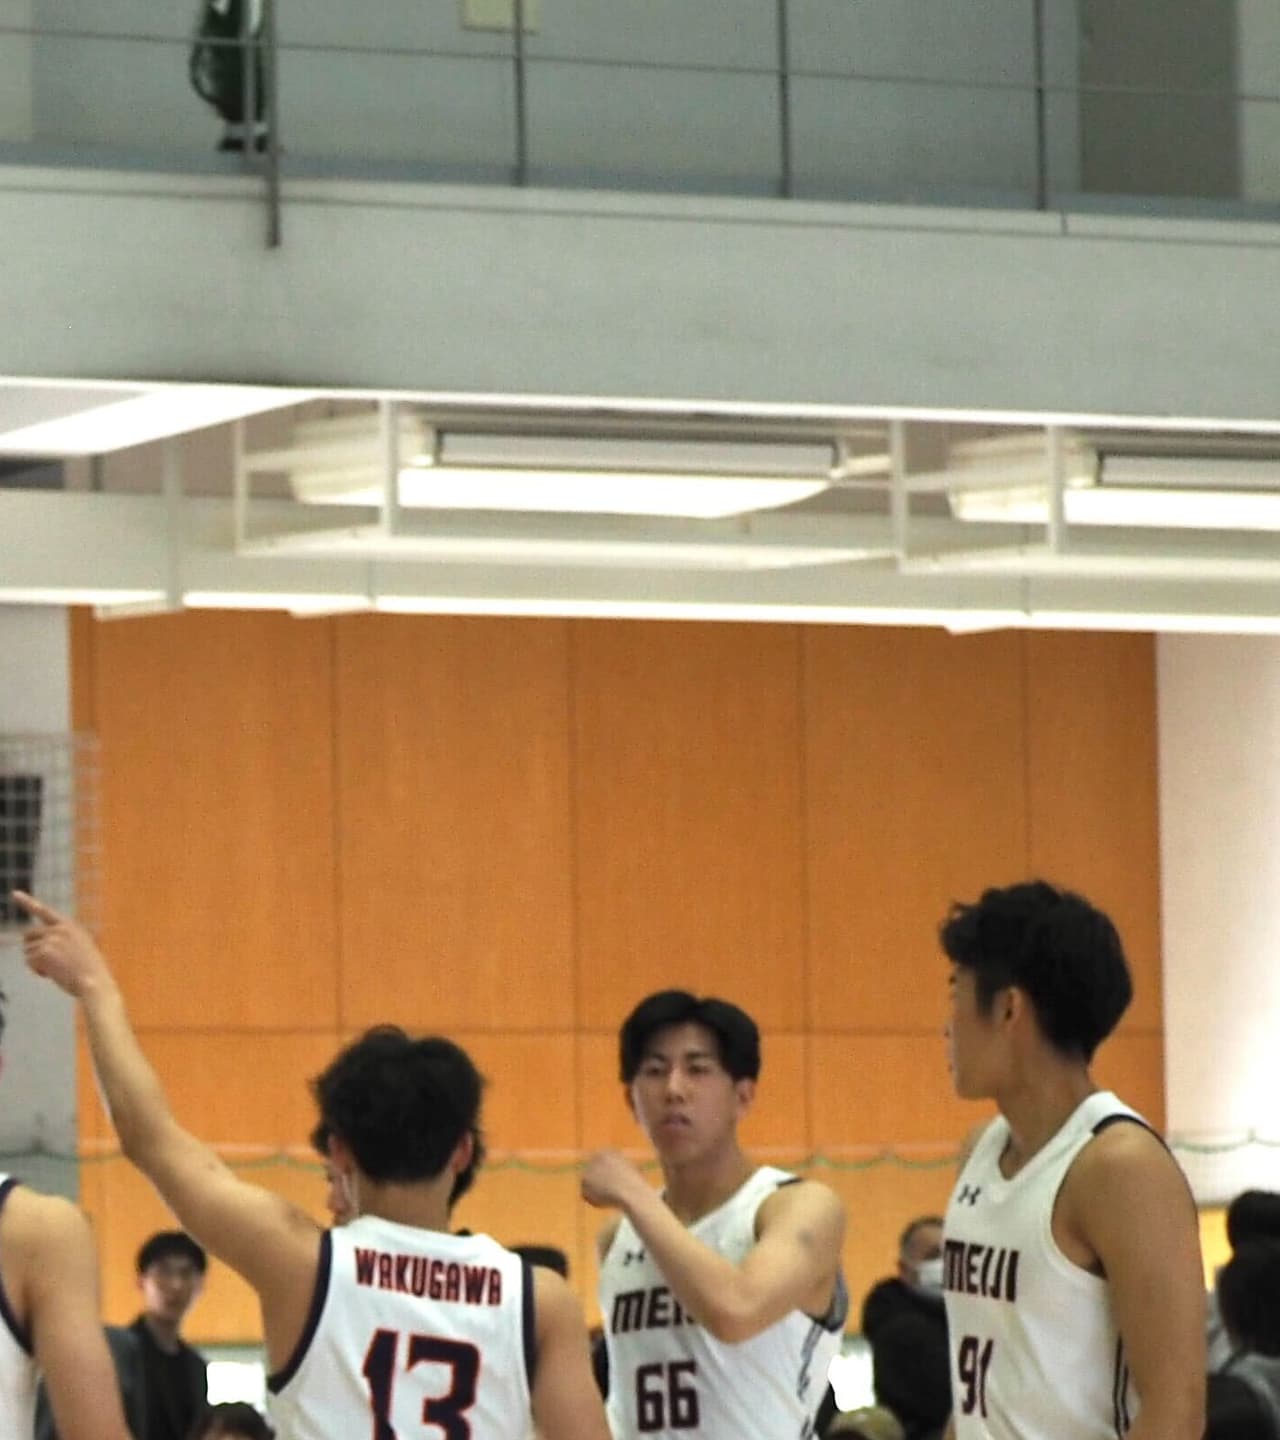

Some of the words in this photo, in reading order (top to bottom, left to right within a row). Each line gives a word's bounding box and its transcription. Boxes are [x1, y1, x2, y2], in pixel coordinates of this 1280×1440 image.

[354, 1246, 502, 1305] WAKUGAWA
[636, 1359, 700, 1433] 66
[959, 1337, 994, 1418] 91
